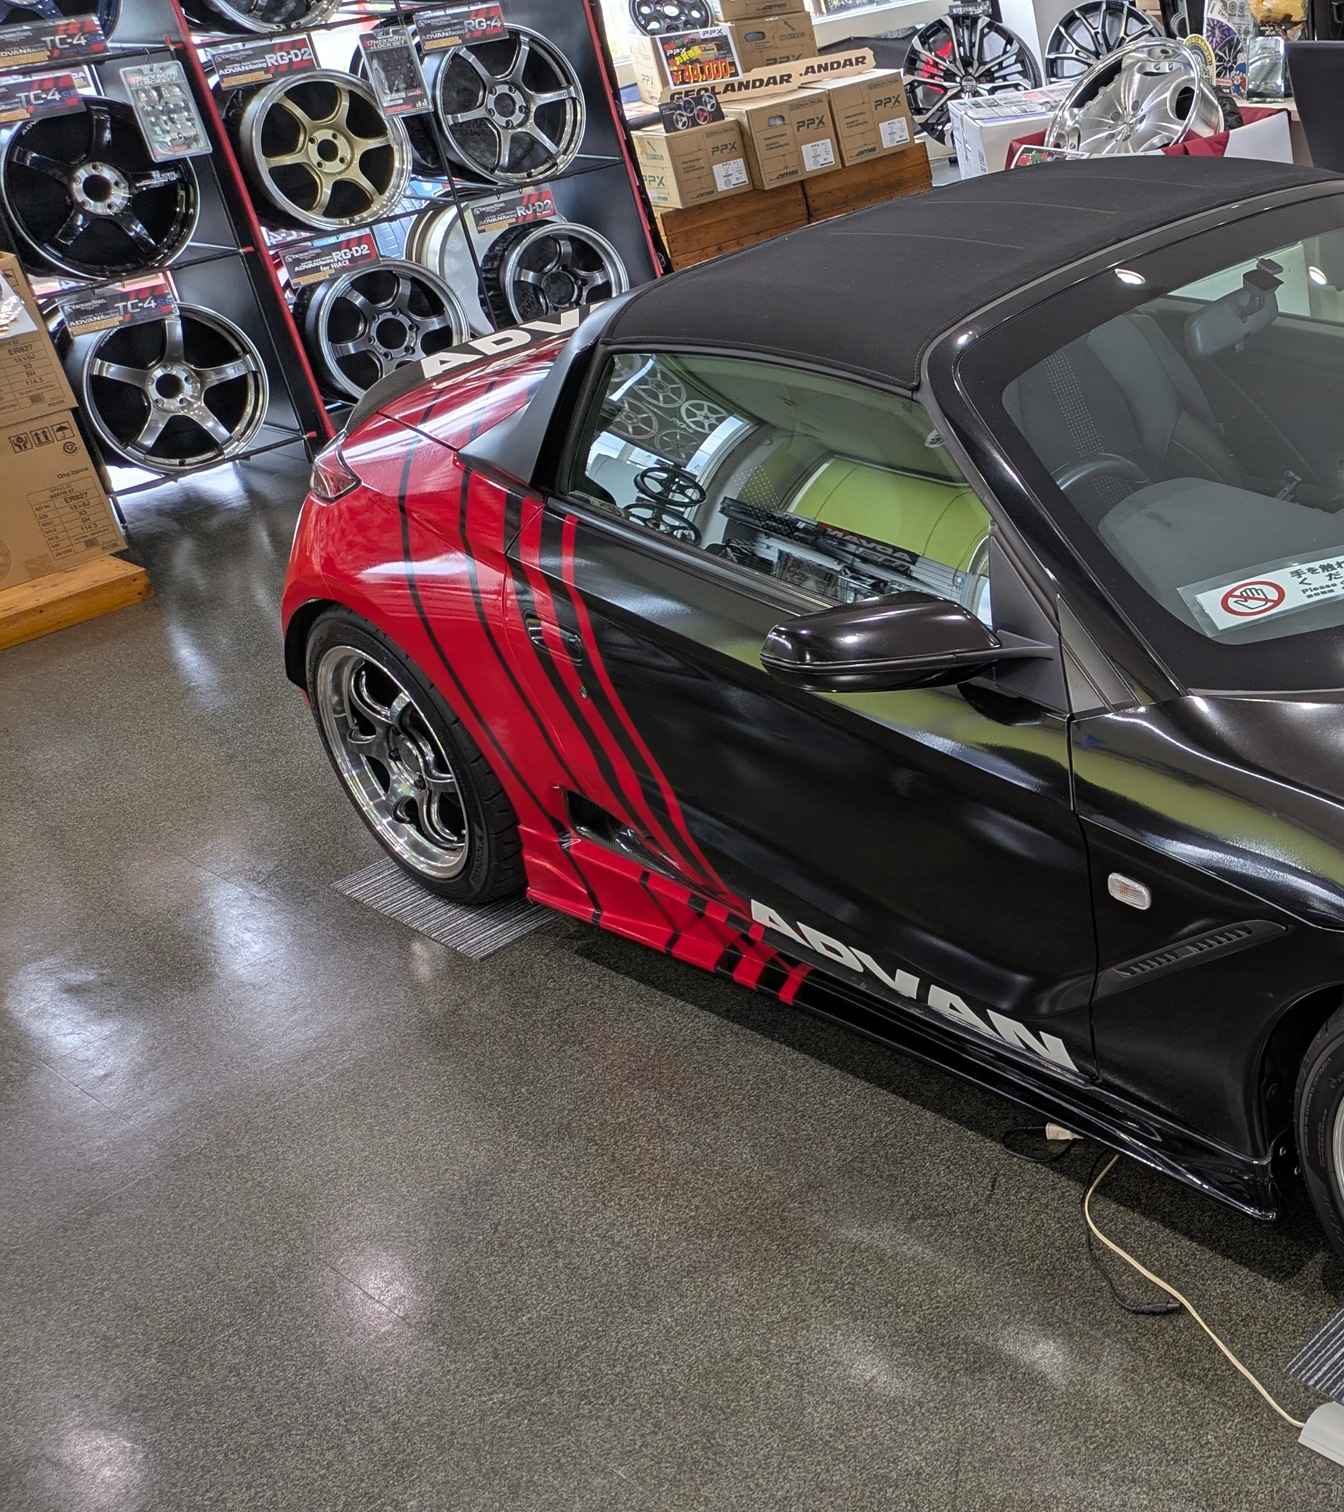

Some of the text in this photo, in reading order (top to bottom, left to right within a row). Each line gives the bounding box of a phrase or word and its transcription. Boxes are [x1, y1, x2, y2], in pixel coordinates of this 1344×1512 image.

[40, 32, 88, 50] TC-4
[264, 48, 314, 67] RG-D2
[800, 55, 867, 77] ANDAR
[16, 88, 61, 108] TC-4
[874, 95, 901, 111] PPX
[796, 115, 826, 132] PPX
[711, 141, 737, 157] PPX
[332, 244, 370, 262] RG-D2
[114, 296, 156, 315] TC-4
[420, 303, 600, 379] ADV
[1301, 583, 1338, 595] Please
[750, 898, 1081, 1073] ADVAN
